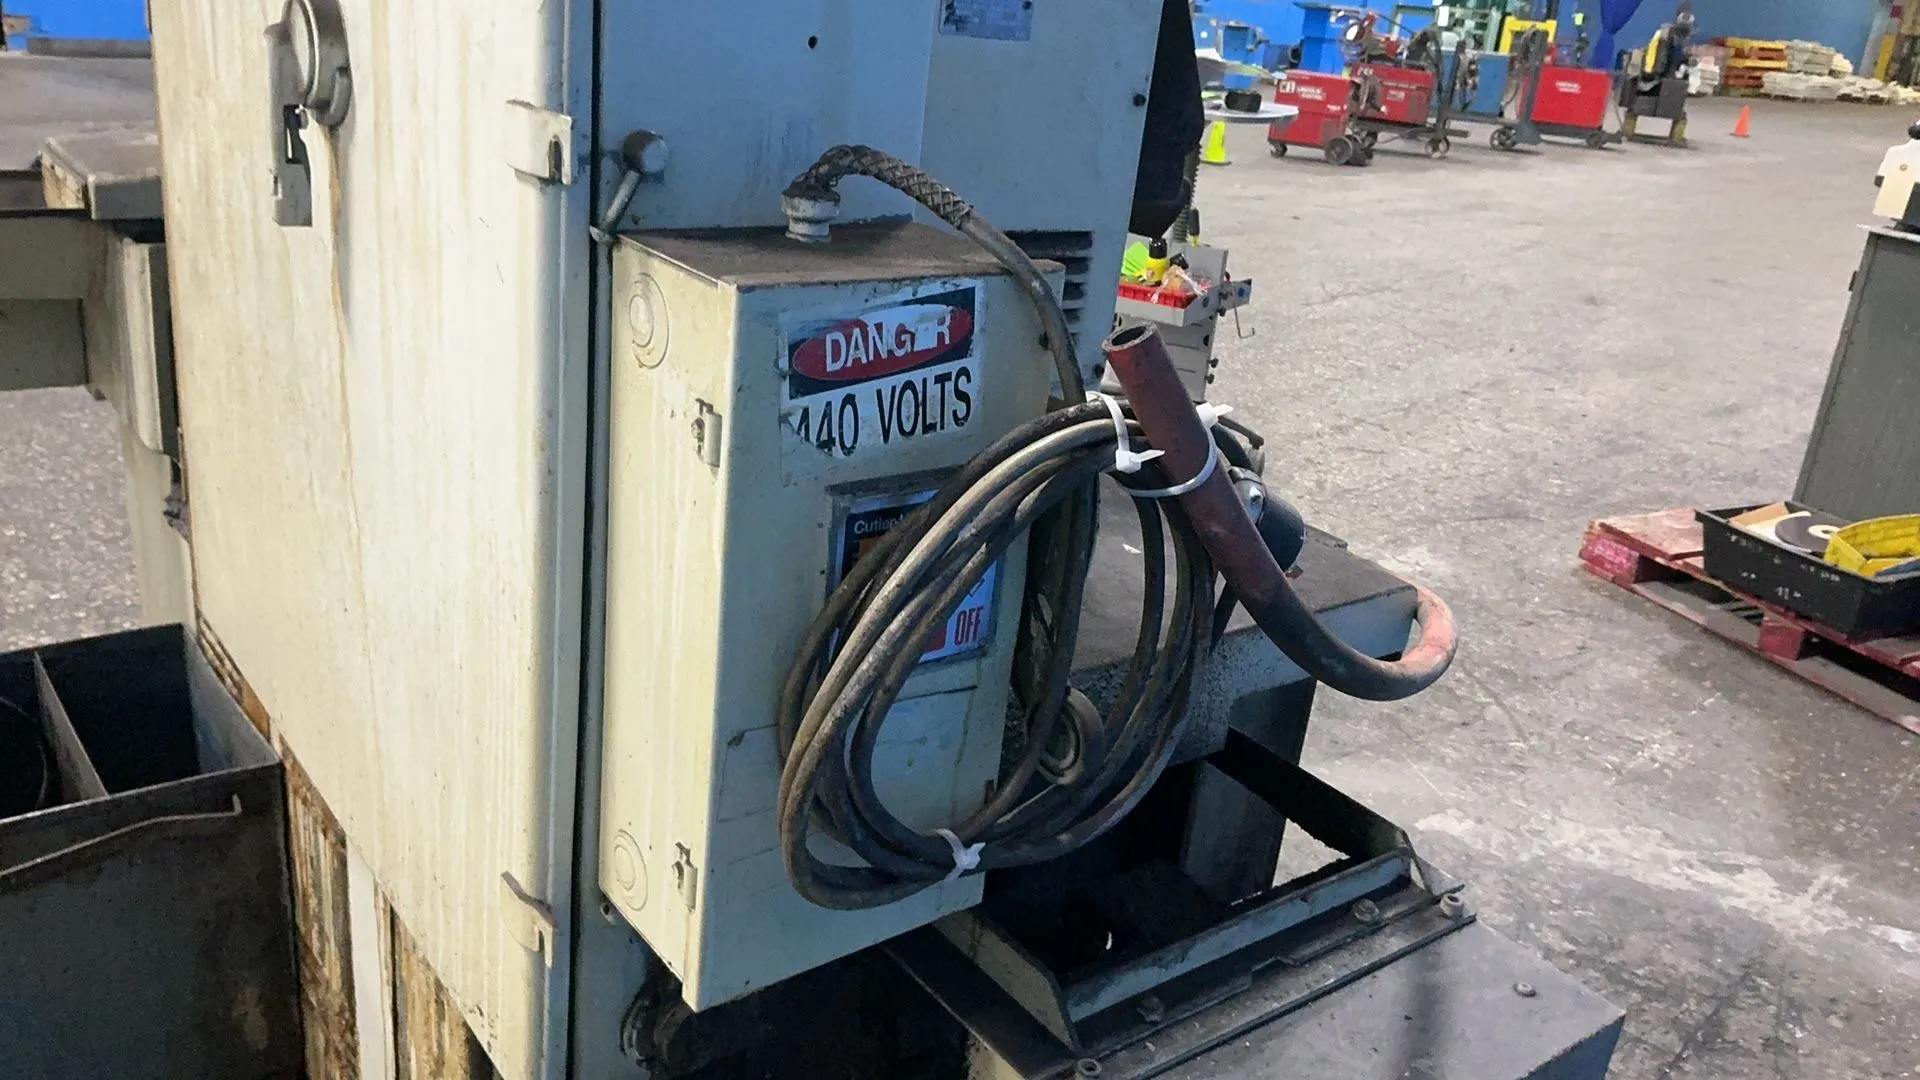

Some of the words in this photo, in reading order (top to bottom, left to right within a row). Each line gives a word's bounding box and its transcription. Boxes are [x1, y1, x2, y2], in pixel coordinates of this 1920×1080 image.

[826, 315, 950, 372] DANGR
[876, 366, 972, 445] VOLTS
[954, 606, 984, 646] OFF
